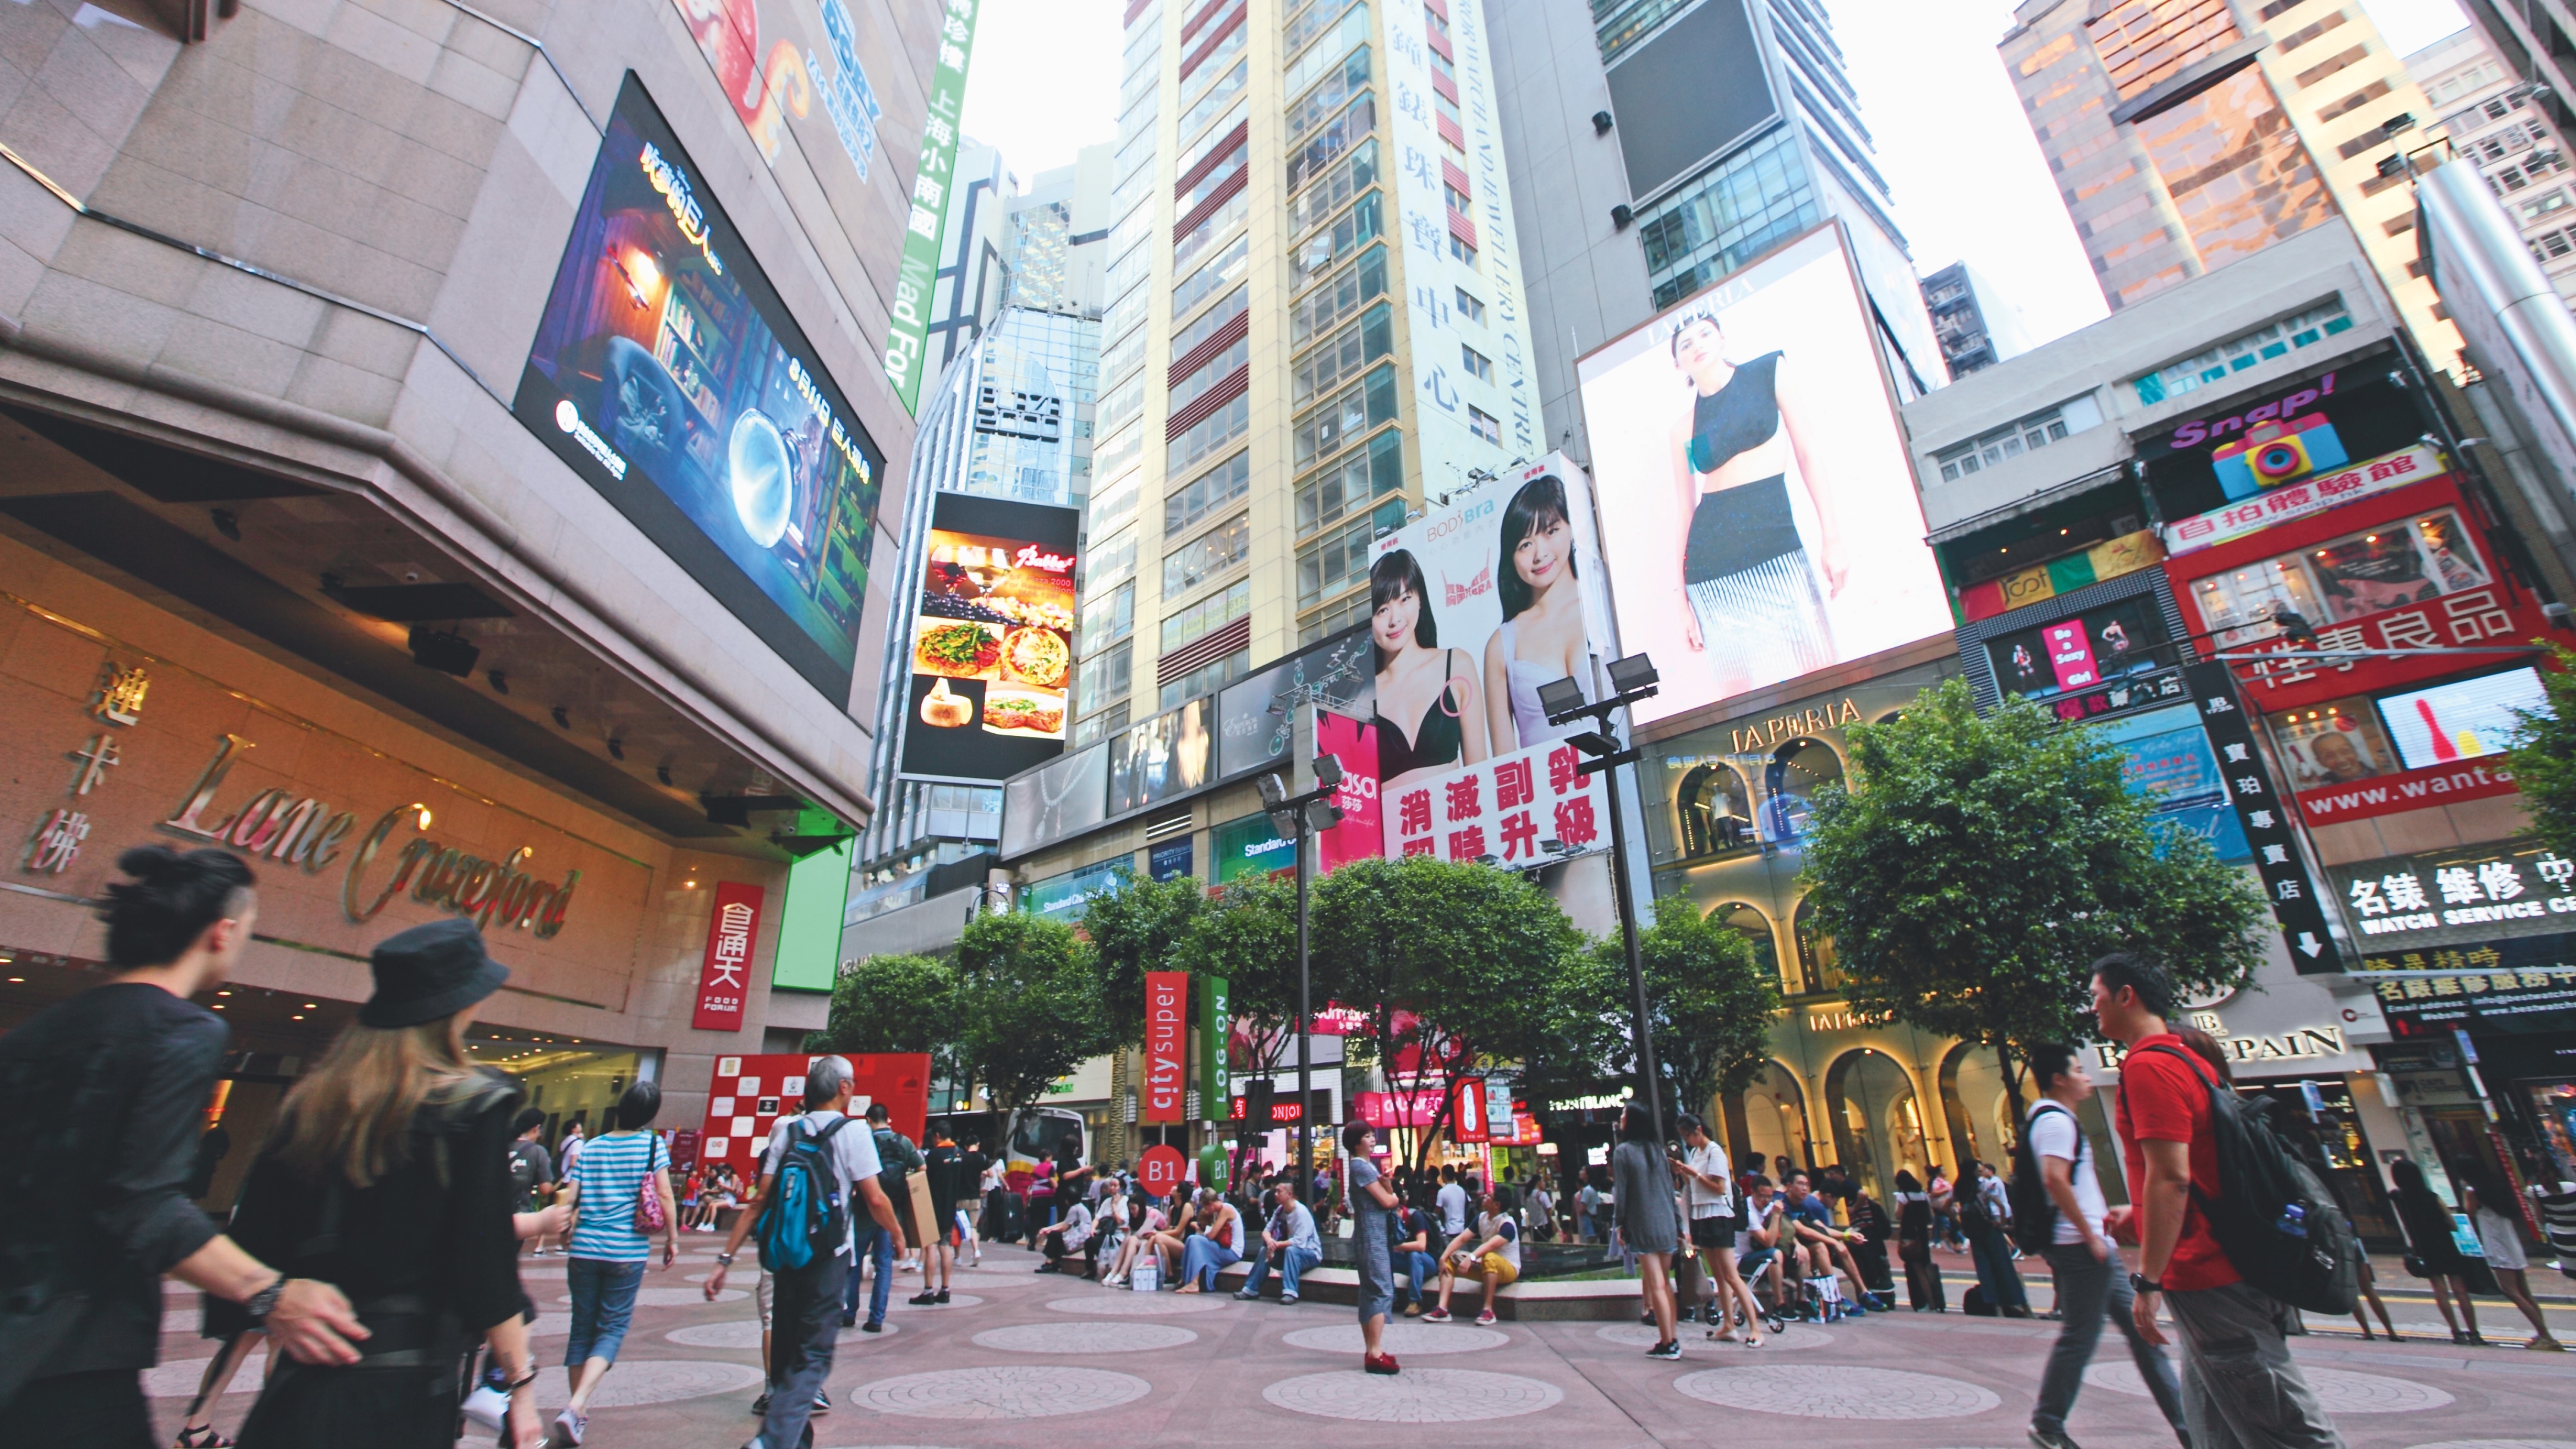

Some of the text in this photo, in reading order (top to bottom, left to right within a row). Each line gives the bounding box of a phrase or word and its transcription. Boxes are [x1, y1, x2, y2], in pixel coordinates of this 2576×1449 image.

[908, 89, 956, 242] 上海小南國
[886, 254, 930, 390] Mad For
[789, 357, 831, 428] 8月11日
[1504, 333, 1533, 455] CENTRE
[2170, 371, 2336, 449] Snap!
[2177, 453, 2418, 541] 自拍體驗館
[1027, 575, 1049, 585] Plaza
[1050, 578, 1072, 587] 2000
[2053, 629, 2072, 641] Be
[2055, 650, 2086, 665] Sexy
[2252, 590, 2515, 689] 性事良品
[2067, 670, 2093, 686] Girl
[23, 662, 151, 875] 連卡佛
[1400, 743, 1592, 836] 消滅副乳
[156, 733, 582, 939] Lane Crawford
[2223, 742, 2302, 901] 寶珀專賣店
[1043, 894, 1072, 913] Standard
[2359, 896, 2576, 936] WATCH SERVICE CE
[711, 902, 754, 989] 食通天
[703, 1002, 738, 1013] FORUM
[705, 996, 739, 1006] FOOD
[2387, 1002, 2418, 1013] Email
[1216, 995, 1226, 1103] LOG-ON
[2094, 1026, 2346, 1070] BPAIN
[1148, 1160, 1175, 1182] B1
[1214, 1159, 1227, 1180] B1
